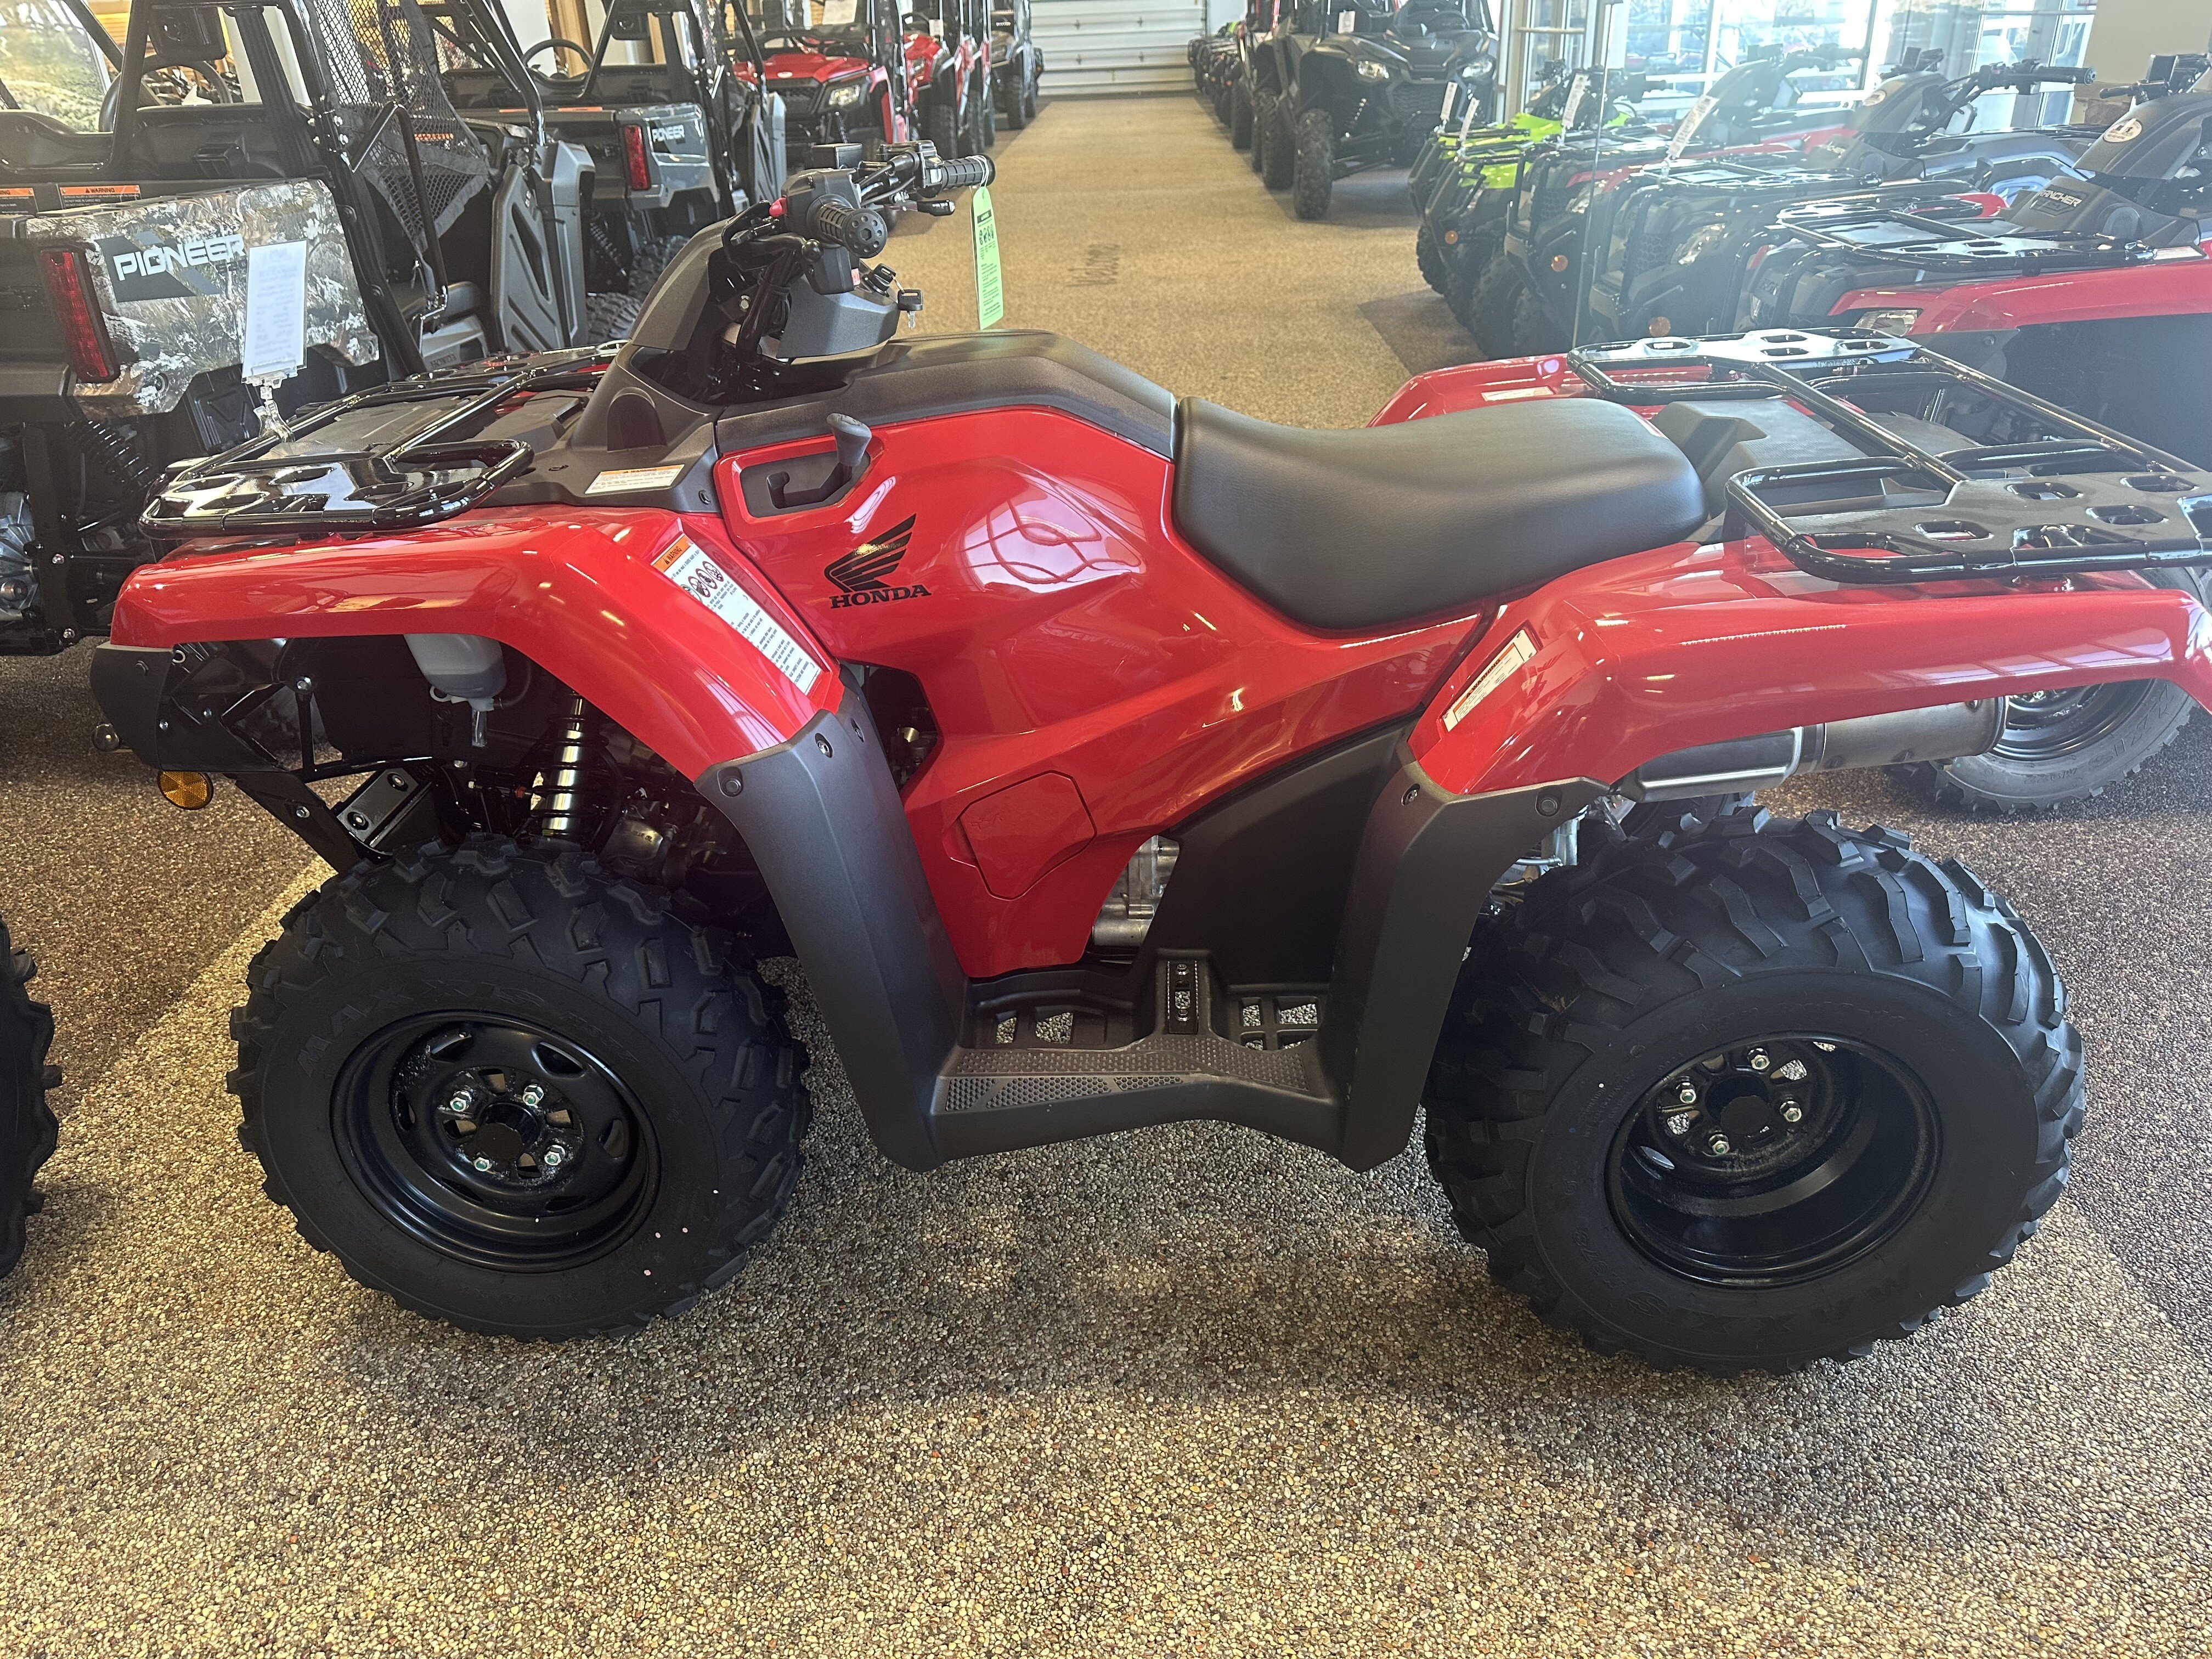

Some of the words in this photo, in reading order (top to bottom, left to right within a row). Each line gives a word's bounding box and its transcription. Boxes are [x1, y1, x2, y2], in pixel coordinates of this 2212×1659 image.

[652, 125, 685, 142] PIONEER
[2039, 189, 2083, 207] RANCHER
[112, 233, 246, 281] PIONEER
[667, 546, 682, 561] WARNING
[829, 584, 932, 609] HONDA
[1471, 658, 1500, 691] WARNING
[297, 978, 544, 1079] MAXXIS
[1627, 1265, 1911, 1336] MAXXIS
